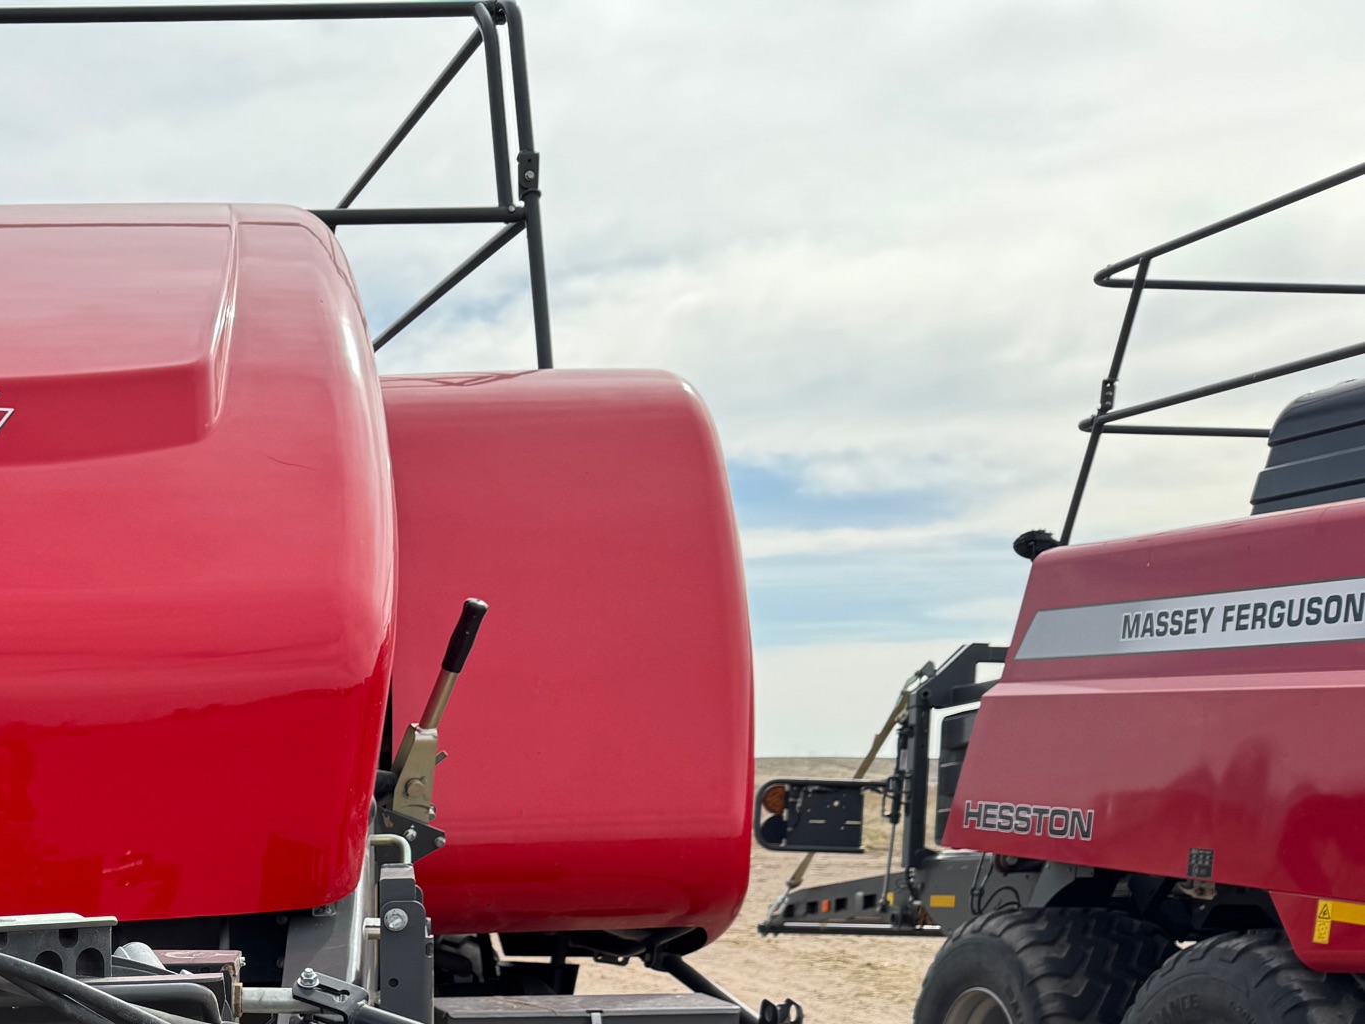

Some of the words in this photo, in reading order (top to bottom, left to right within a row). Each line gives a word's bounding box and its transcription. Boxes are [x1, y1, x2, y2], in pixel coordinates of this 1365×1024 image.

[1121, 607, 1214, 640] MASSEY
[1221, 592, 1365, 631] FERGUSON
[962, 800, 1094, 841] HESSTON
